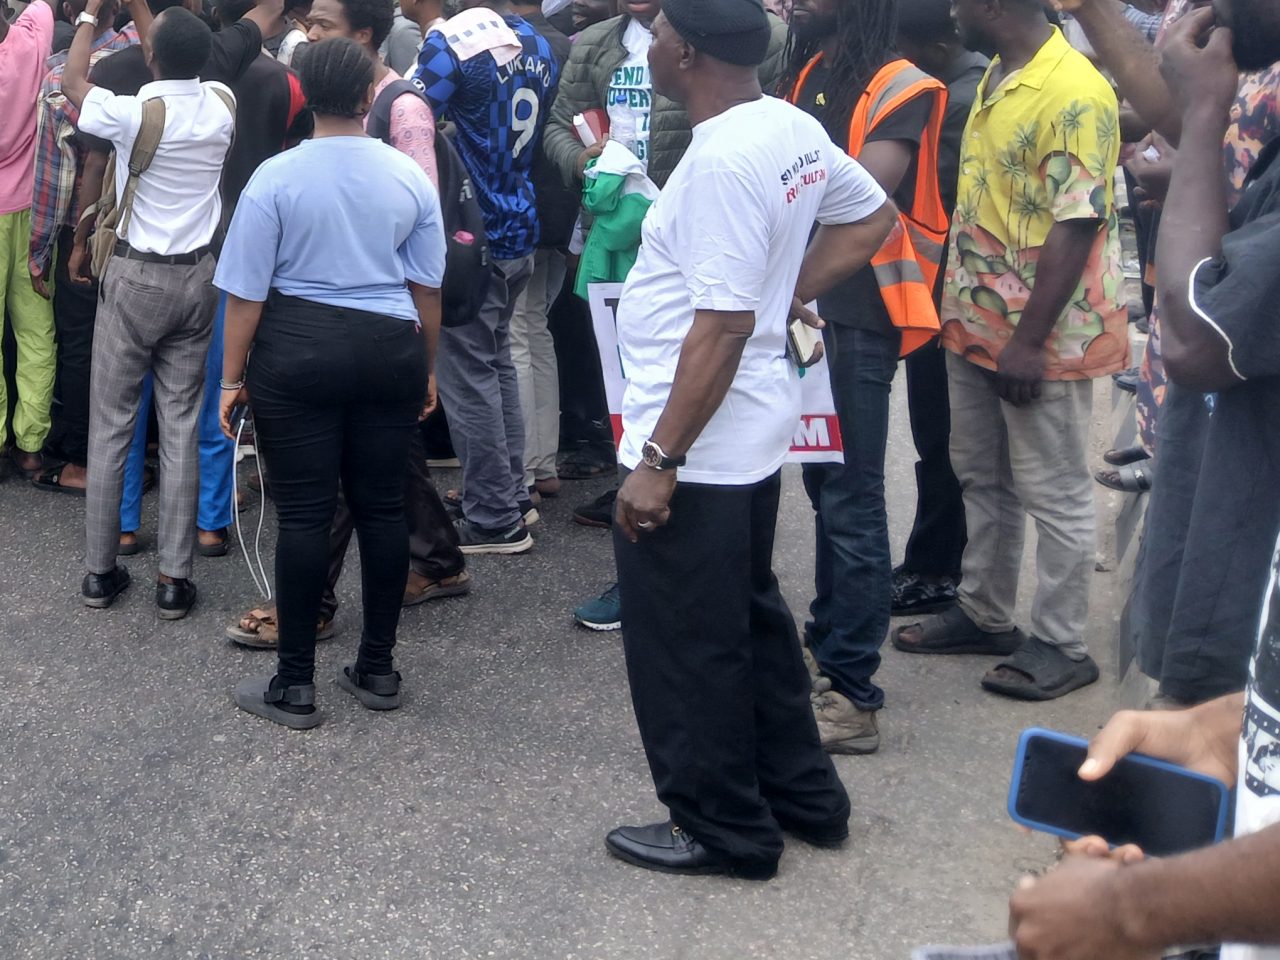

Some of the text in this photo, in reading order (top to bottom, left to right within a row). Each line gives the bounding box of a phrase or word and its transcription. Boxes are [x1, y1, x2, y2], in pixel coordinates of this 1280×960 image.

[496, 54, 551, 88] LUKAKU
[613, 66, 644, 86] END
[512, 87, 539, 158] 9
